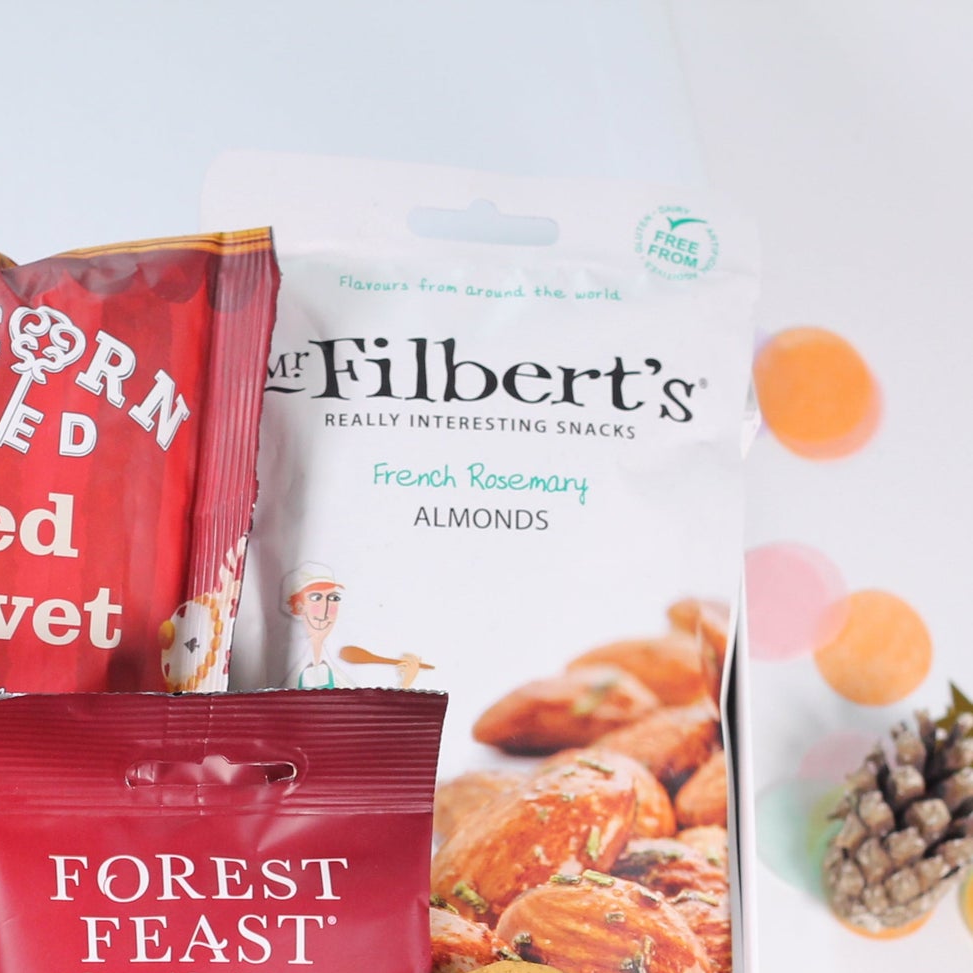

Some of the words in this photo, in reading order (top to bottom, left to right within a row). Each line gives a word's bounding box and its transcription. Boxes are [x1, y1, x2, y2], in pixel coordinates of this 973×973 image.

[654, 230, 699, 255] FREE
[648, 244, 698, 268] FROM
[339, 275, 408, 291] Flavours
[419, 278, 457, 294] from
[466, 284, 525, 298] around
[535, 286, 566, 298] the
[575, 288, 622, 300] world
[325, 413, 400, 427] REALLY
[410, 414, 548, 434] INTERESTING
[557, 421, 636, 439] SNACKS
[373, 462, 457, 488] French
[467, 462, 589, 505] Rosemary
[413, 506, 549, 531] ALMONDS
[48, 853, 349, 903] FOREST
[80, 913, 325, 965] FEAST
